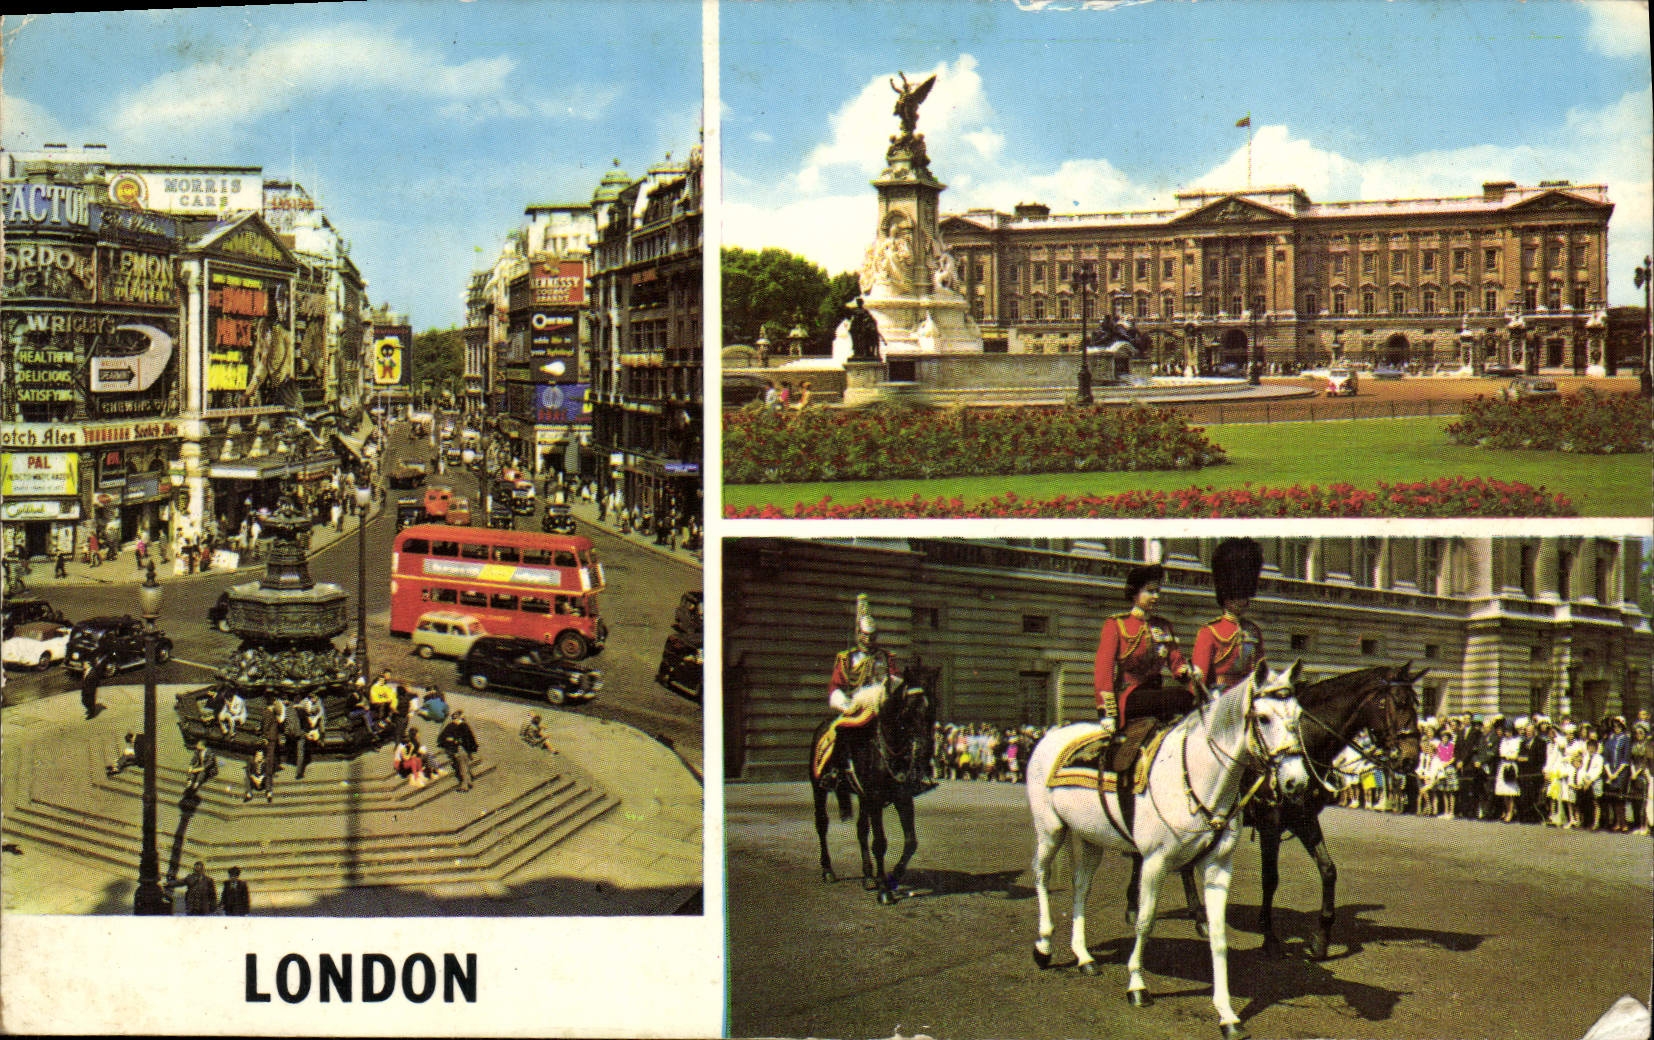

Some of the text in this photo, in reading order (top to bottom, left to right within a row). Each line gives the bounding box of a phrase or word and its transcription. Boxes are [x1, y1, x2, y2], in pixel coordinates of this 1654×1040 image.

[164, 178, 242, 193] MORRIS
[179, 194, 229, 208] CARS
[42, 426, 76, 445] Ales
[27, 455, 52, 470] PAL
